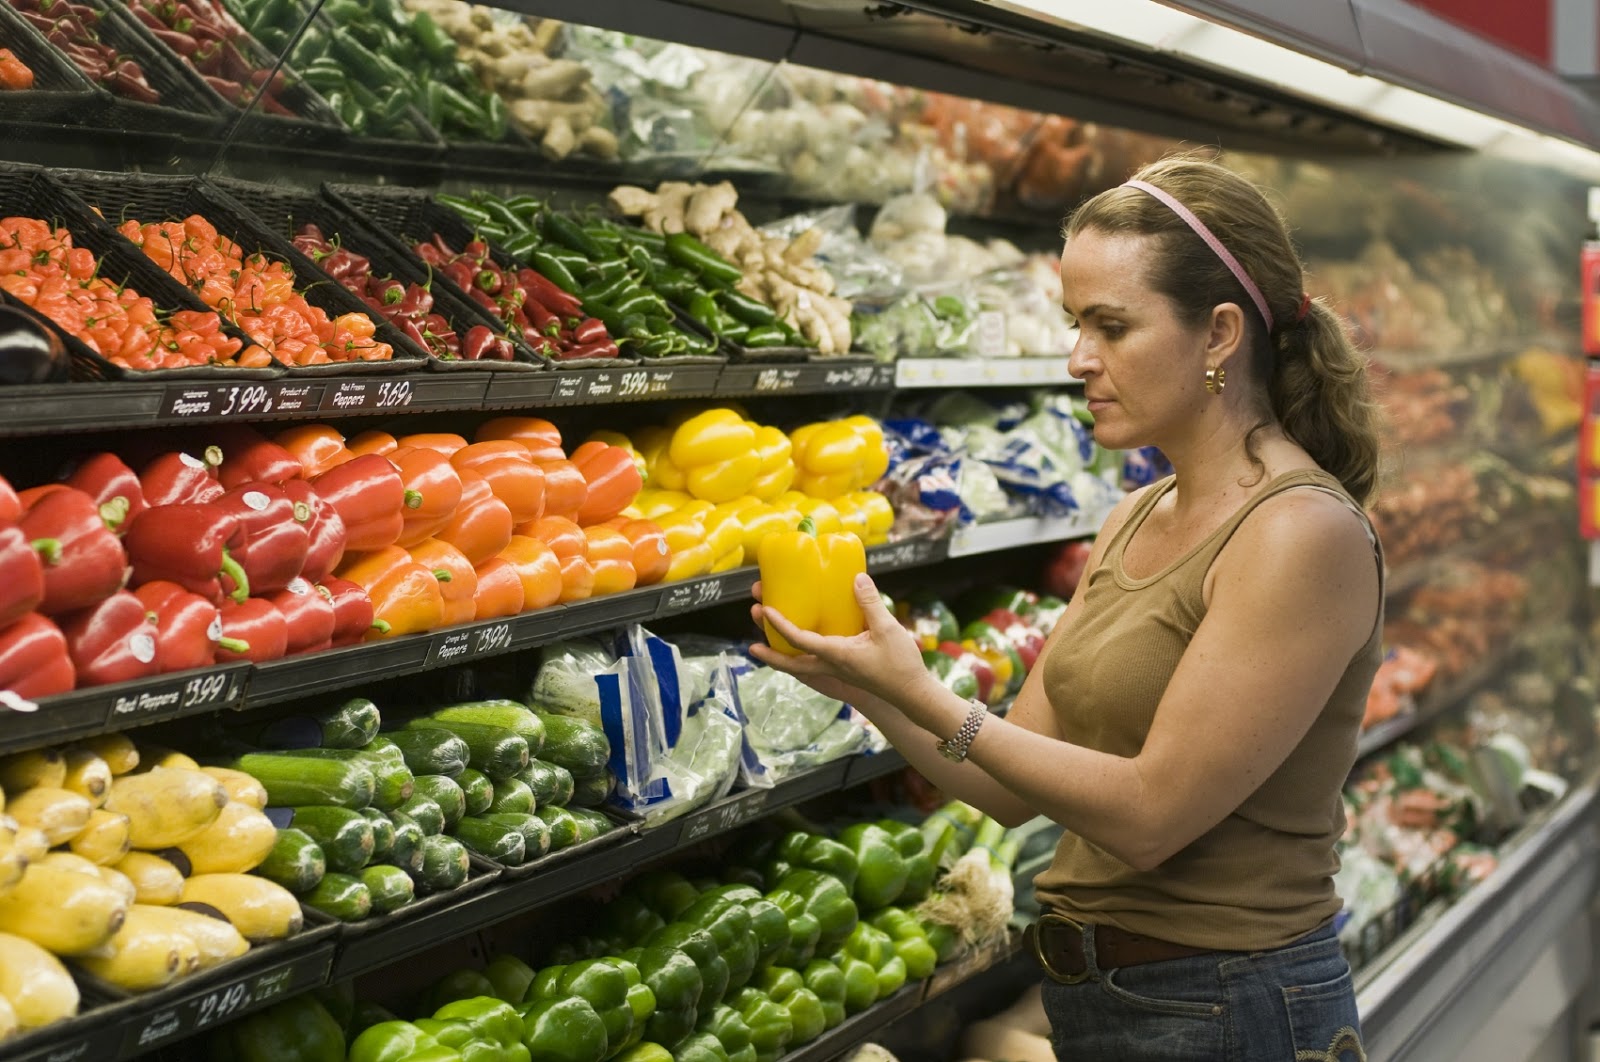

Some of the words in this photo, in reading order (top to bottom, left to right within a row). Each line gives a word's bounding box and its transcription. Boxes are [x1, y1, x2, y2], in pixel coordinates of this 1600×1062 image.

[280, 386, 302, 396] Product
[301, 385, 311, 396] of
[171, 398, 211, 417] Peppers
[332, 391, 366, 409] Peppers
[437, 643, 468, 660] Peppers
[114, 696, 139, 714] Red
[138, 692, 179, 711] Peppers
